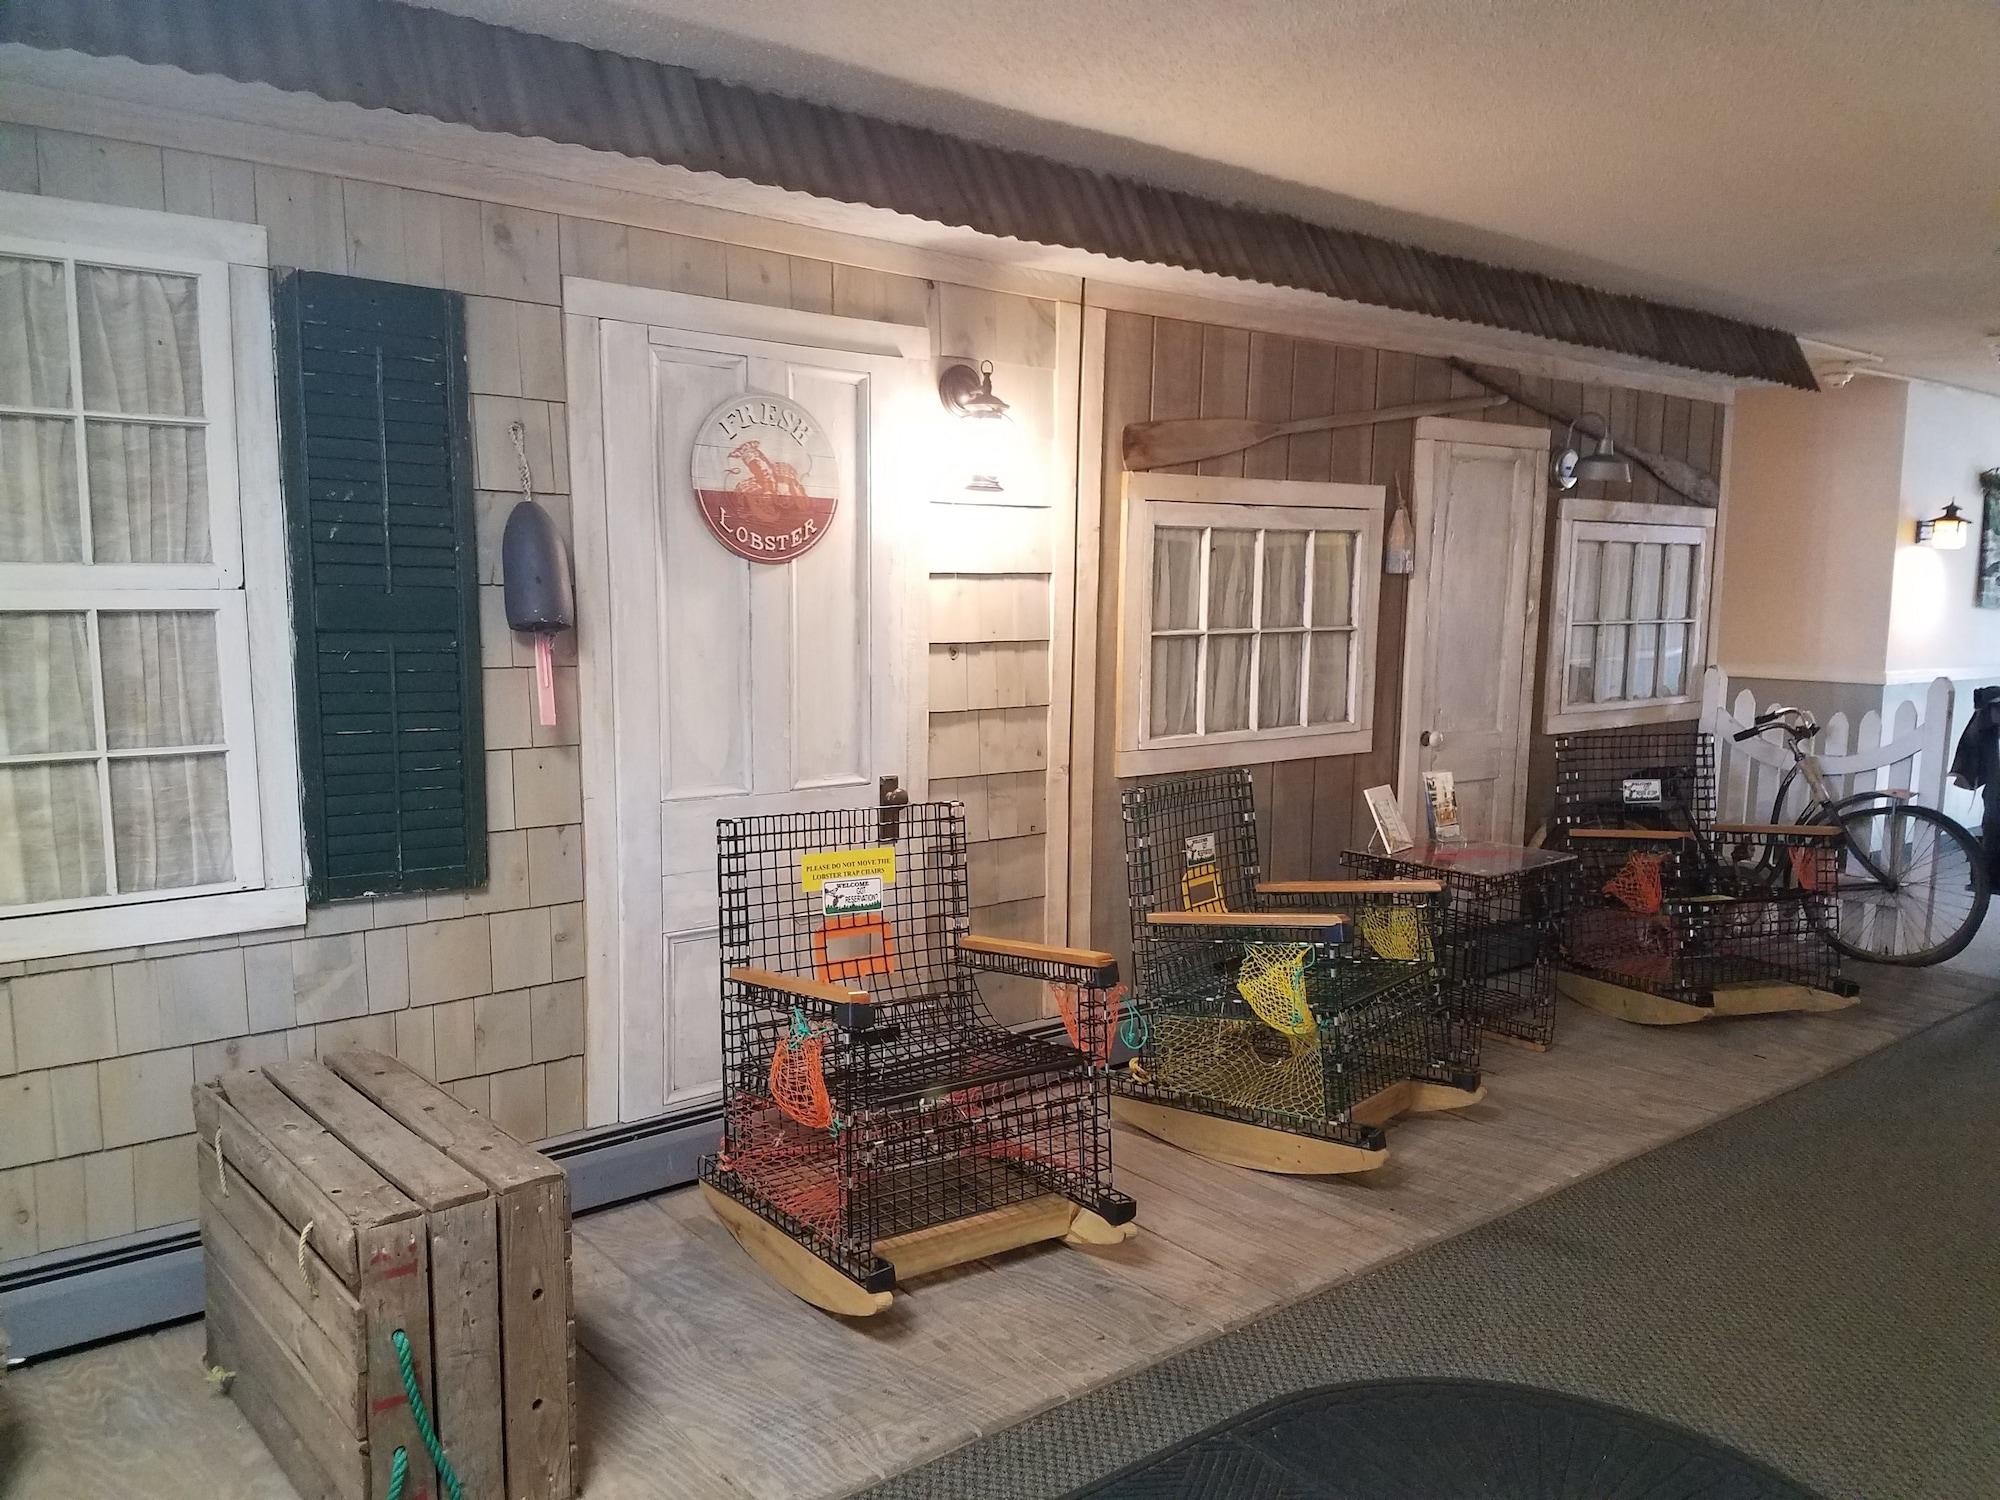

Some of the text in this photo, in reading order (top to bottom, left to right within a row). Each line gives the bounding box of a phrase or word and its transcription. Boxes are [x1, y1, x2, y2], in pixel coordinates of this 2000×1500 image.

[719, 402, 809, 447] FRESH
[720, 506, 817, 551] LOBSTER
[806, 864, 830, 872] PLEASE
[857, 859, 877, 867] MOVE
[812, 872, 841, 880] LOBSTER
[861, 868, 885, 876] CHAIRS
[856, 886, 866, 894] GOT
